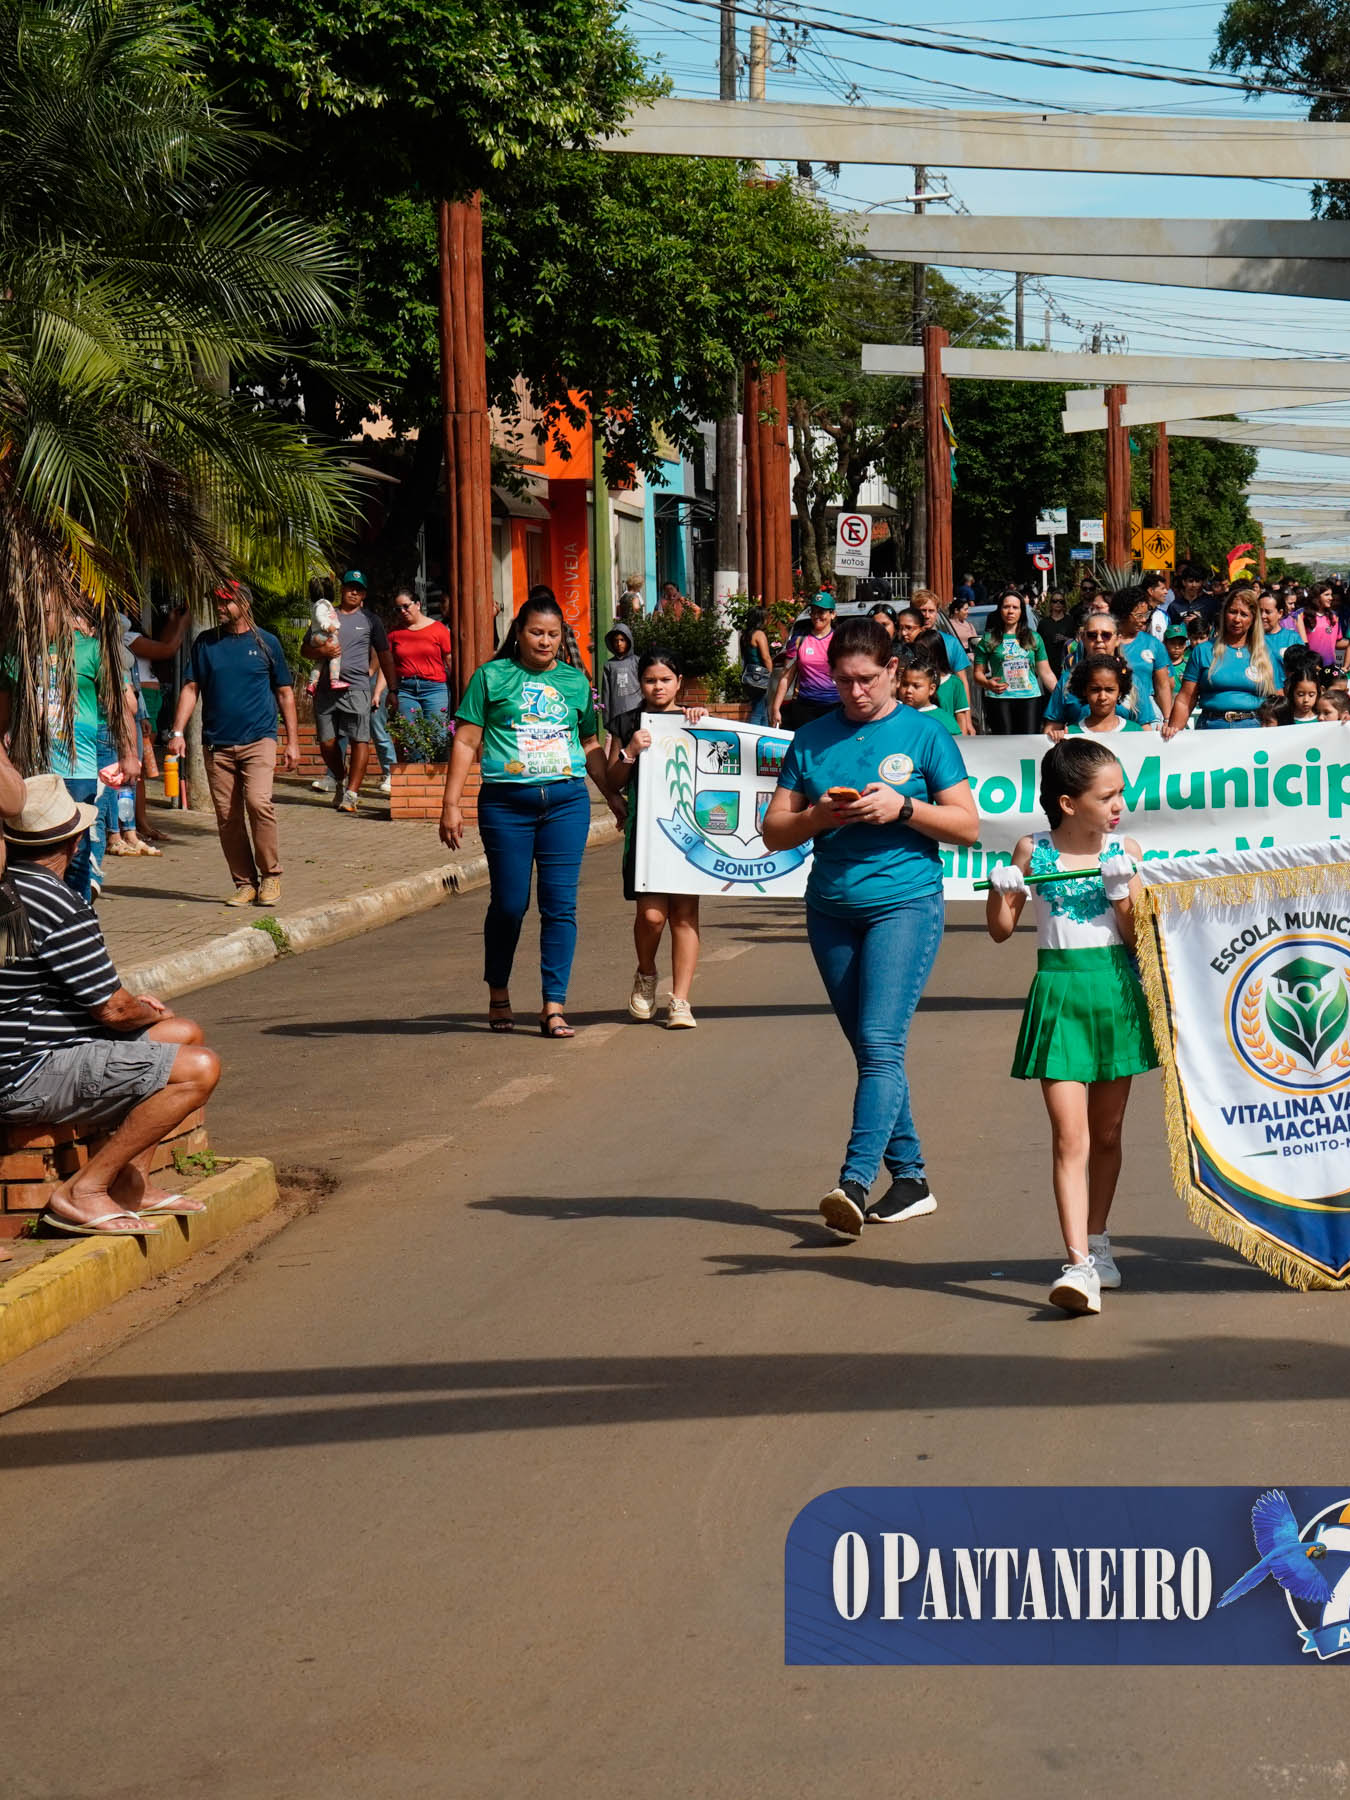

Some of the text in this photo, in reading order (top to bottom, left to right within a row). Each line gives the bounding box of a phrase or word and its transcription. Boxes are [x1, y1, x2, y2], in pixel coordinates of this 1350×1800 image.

[564, 543, 579, 582] VEJA
[841, 557, 865, 567] MOTOS
[672, 824, 694, 845] 2-10
[712, 859, 777, 877] BONITO
[1210, 916, 1283, 975] ESCOLA
[1221, 1096, 1326, 1126] VITALINA
